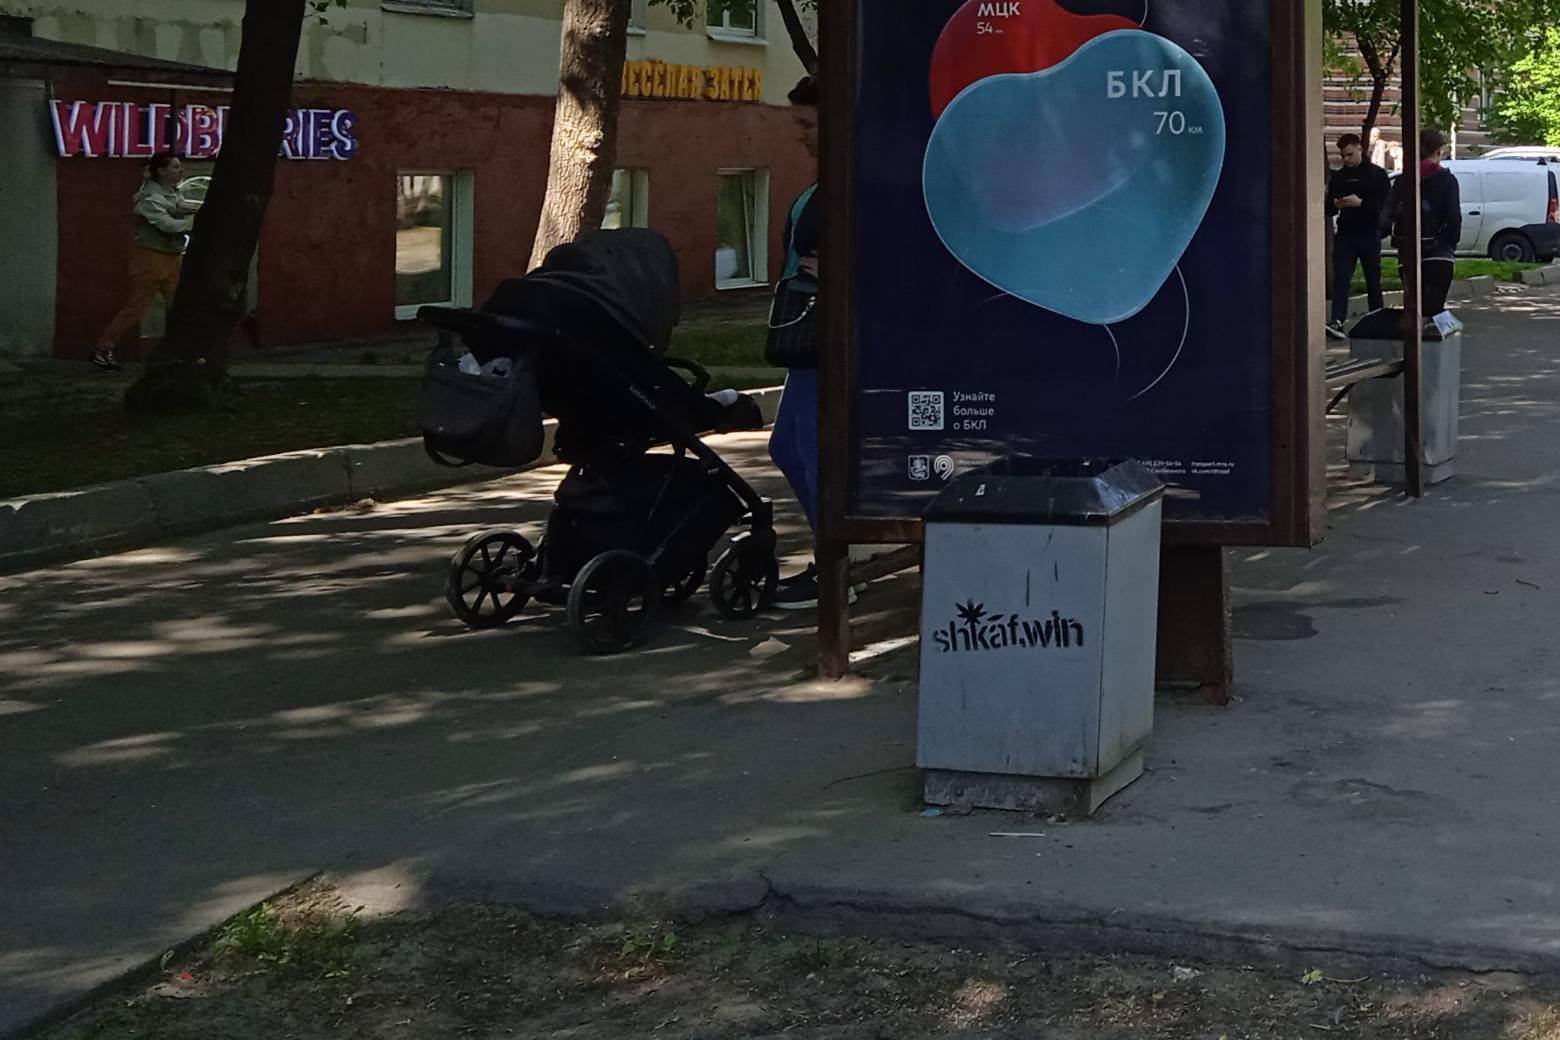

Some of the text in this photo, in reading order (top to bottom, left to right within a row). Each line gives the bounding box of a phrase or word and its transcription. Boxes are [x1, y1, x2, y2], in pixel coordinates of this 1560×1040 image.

[977, 1, 1021, 18] МЦК
[976, 21, 993, 35] 54
[1107, 69, 1182, 99] БКЛ
[1153, 111, 1185, 135] 70
[953, 391, 996, 402] Узнайте
[953, 405, 995, 416] больше
[953, 420, 986, 430] о БКЛ
